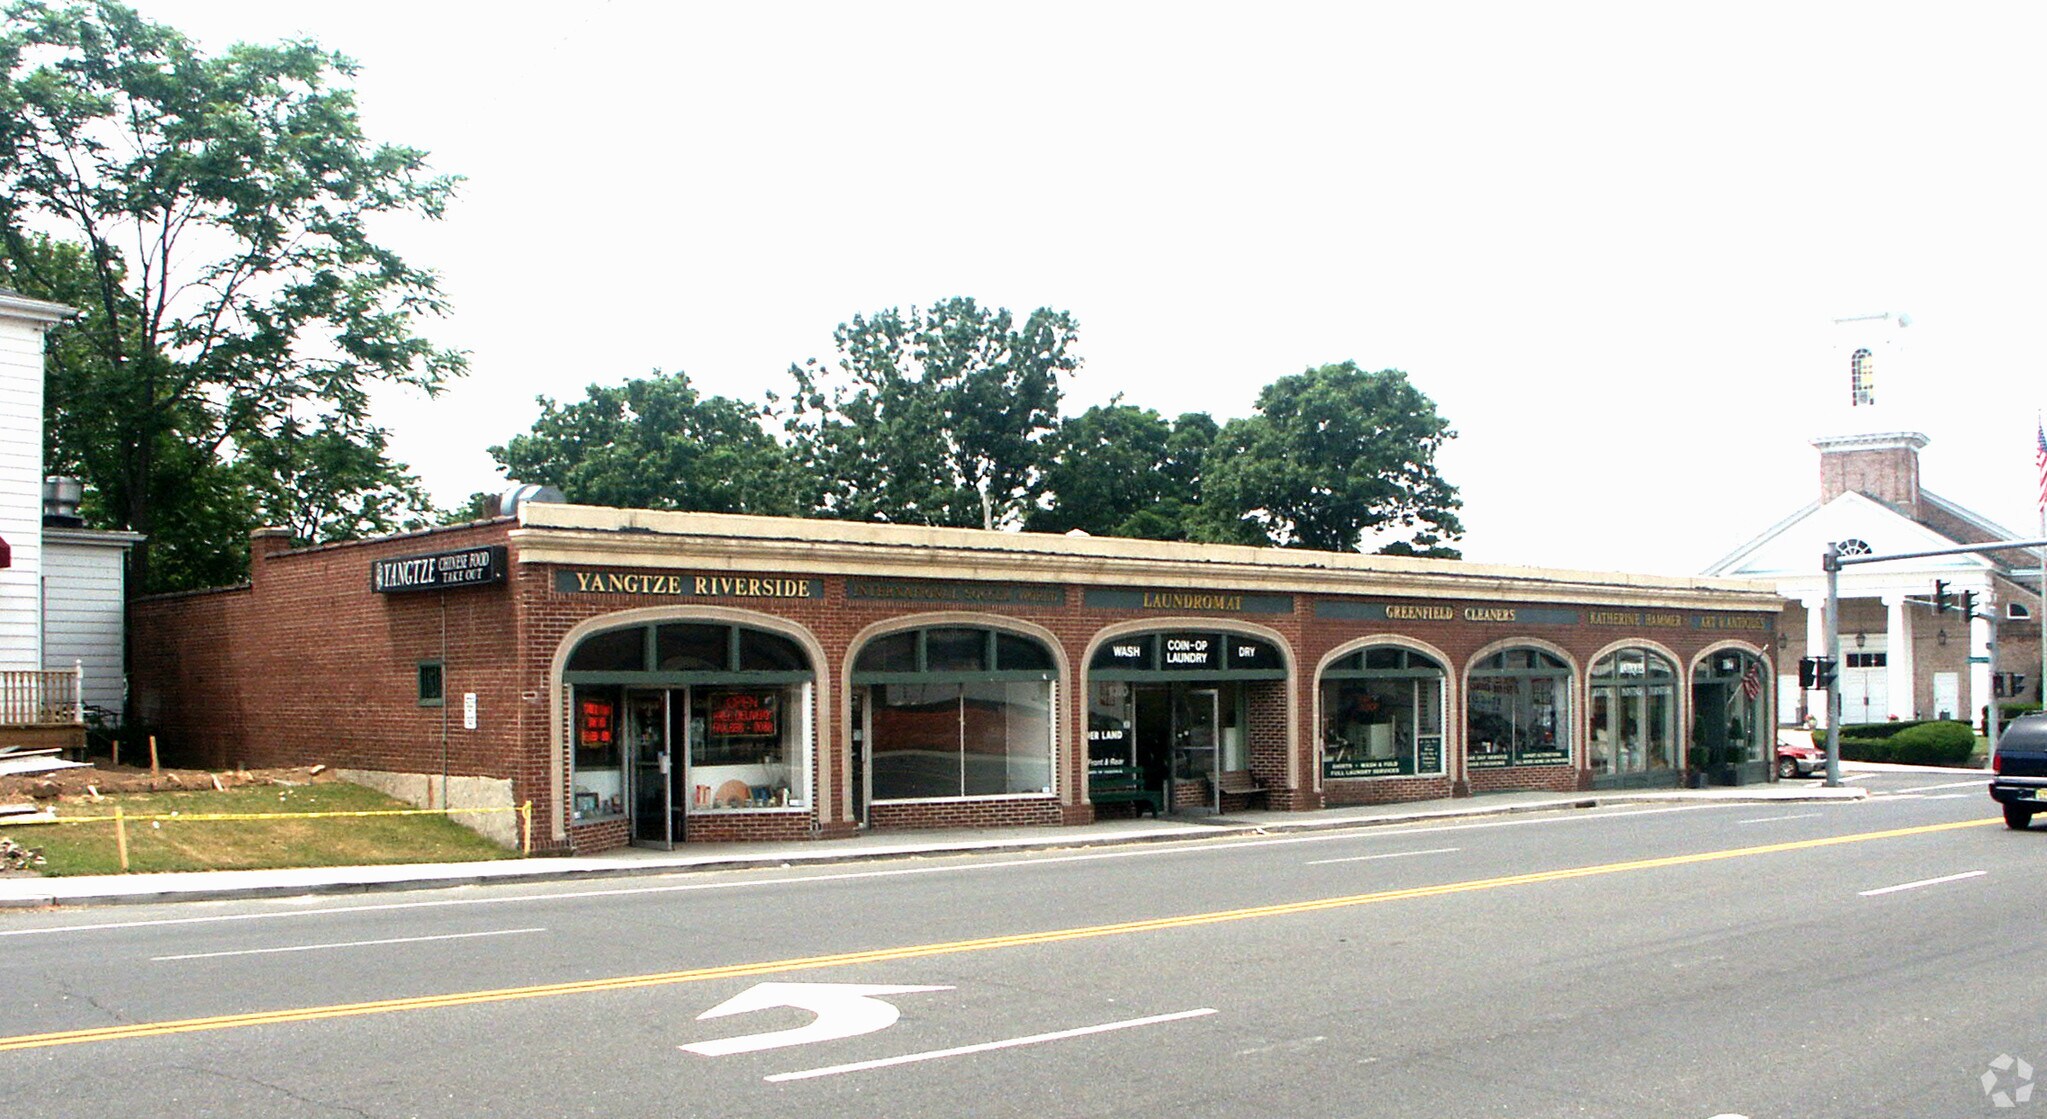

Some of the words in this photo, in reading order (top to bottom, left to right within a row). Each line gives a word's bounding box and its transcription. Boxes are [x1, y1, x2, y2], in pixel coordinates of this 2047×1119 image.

[438, 554, 468, 571] CHINESE
[469, 551, 490, 568] FOOD
[384, 558, 436, 587] YANGTZE
[442, 571, 464, 583] TAKE
[465, 568, 484, 580] OUT
[576, 572, 682, 594] YANGTZE
[695, 576, 811, 598] RIVERSIDE
[1143, 592, 1243, 611] LAUNDROMAT
[1386, 606, 1454, 621] GREENFIELD
[1464, 608, 1516, 622] CLEANERS
[1589, 612, 1640, 626] KATHERINE
[1645, 614, 1681, 627] HAMMER
[1113, 646, 1141, 657] WASH
[1167, 640, 1209, 651] COIN-OP
[1238, 647, 1255, 657] DRY
[1167, 652, 1208, 663] LAUNDRY
[1088, 731, 1100, 740] ER
[1101, 730, 1123, 740] LAND
